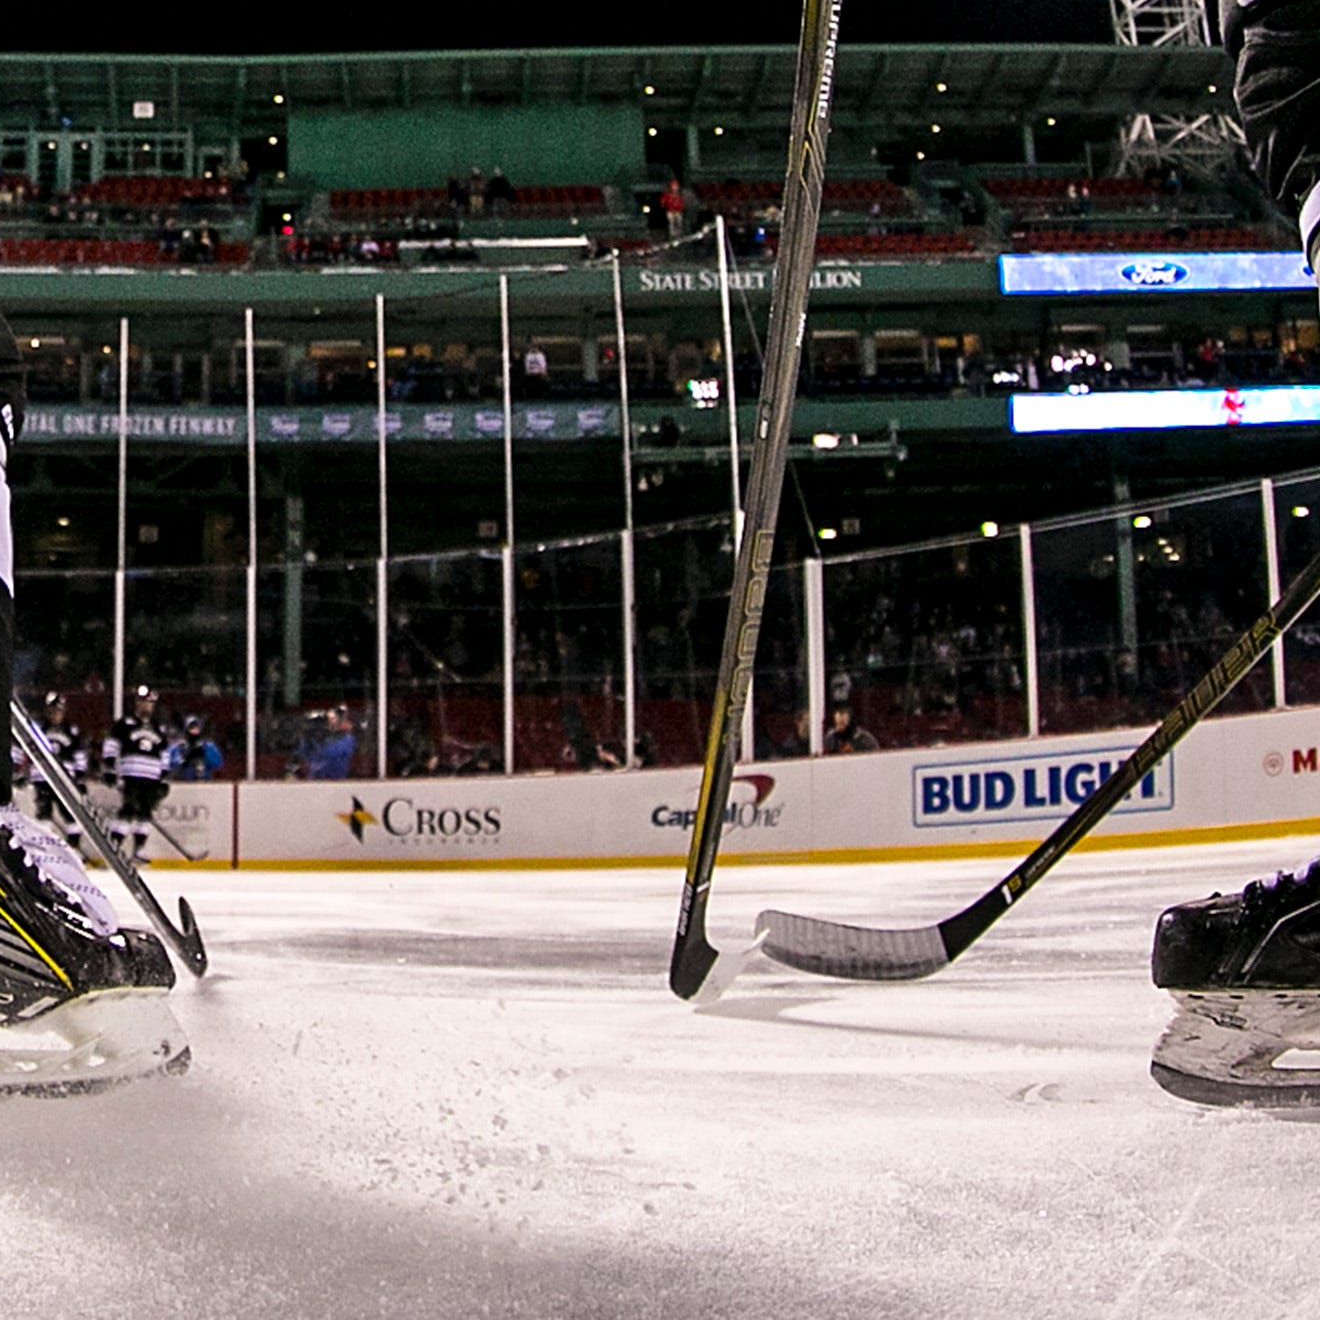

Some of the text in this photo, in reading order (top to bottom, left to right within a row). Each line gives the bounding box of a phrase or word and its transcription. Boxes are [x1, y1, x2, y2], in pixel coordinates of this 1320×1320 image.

[639, 270, 694, 292] STATE
[170, 416, 235, 436] FENWAY
[922, 770, 1016, 816] BUD
[651, 802, 738, 830] Capal
